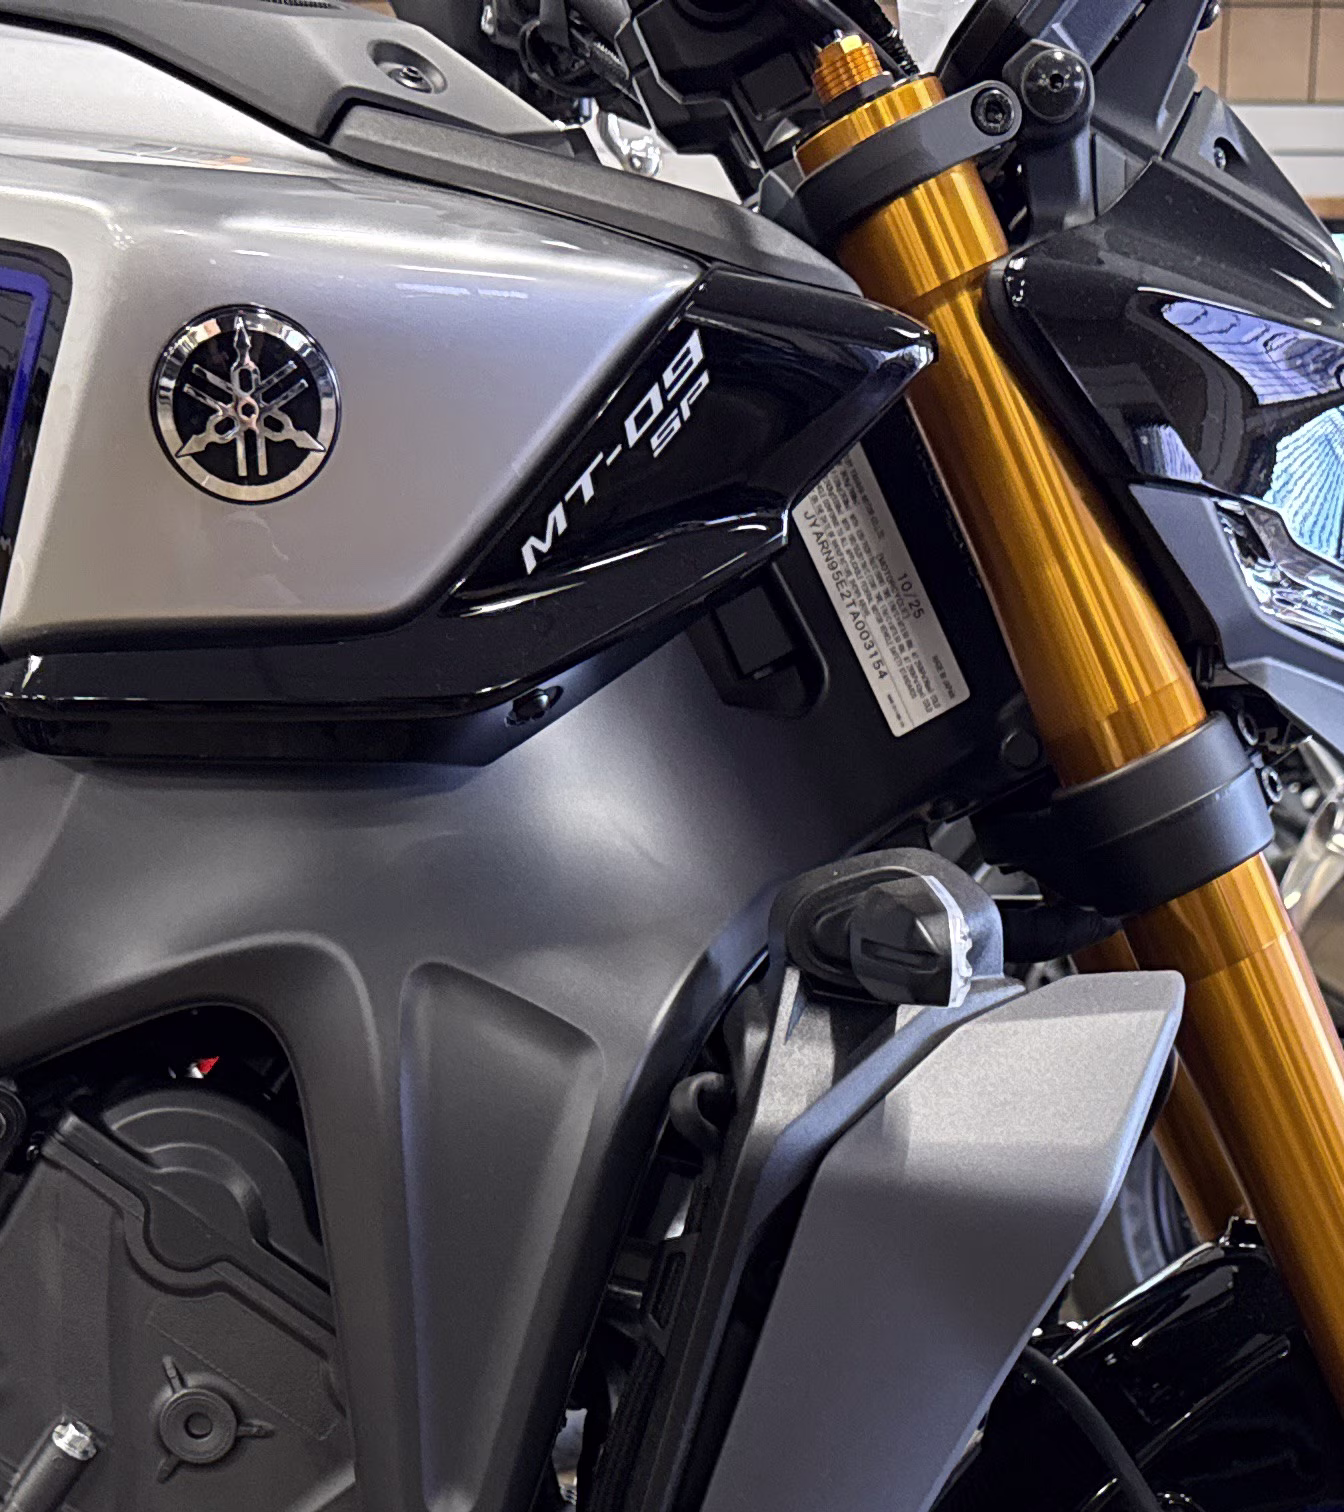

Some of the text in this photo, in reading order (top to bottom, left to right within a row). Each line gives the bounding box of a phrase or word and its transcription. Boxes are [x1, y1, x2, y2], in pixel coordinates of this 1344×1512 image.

[521, 328, 704, 575] MT-09
[650, 369, 709, 458] SP
[804, 511, 888, 679] JYARN95E2TA003154
[897, 572, 926, 620] 10/25
